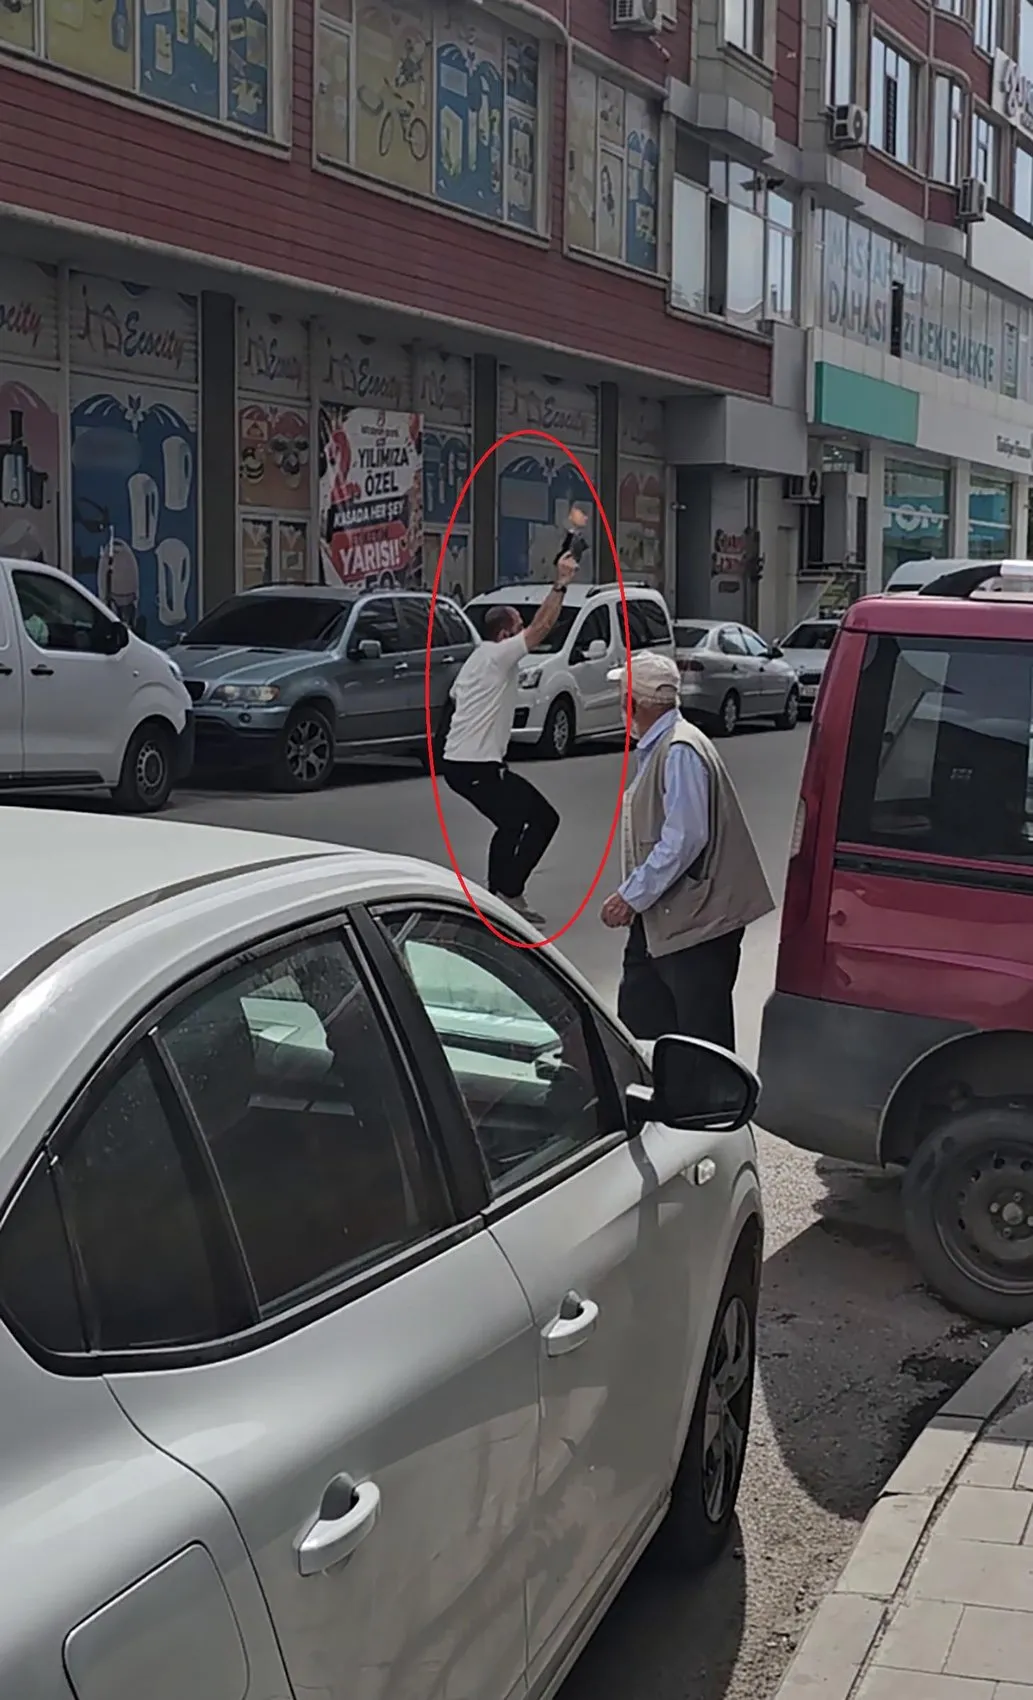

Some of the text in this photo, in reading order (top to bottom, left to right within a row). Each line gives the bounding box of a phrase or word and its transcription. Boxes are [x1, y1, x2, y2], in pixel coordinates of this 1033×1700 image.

[365, 470, 399, 497] ÖZEL
[371, 503, 386, 519] HER
[338, 539, 400, 576] YARISI!
